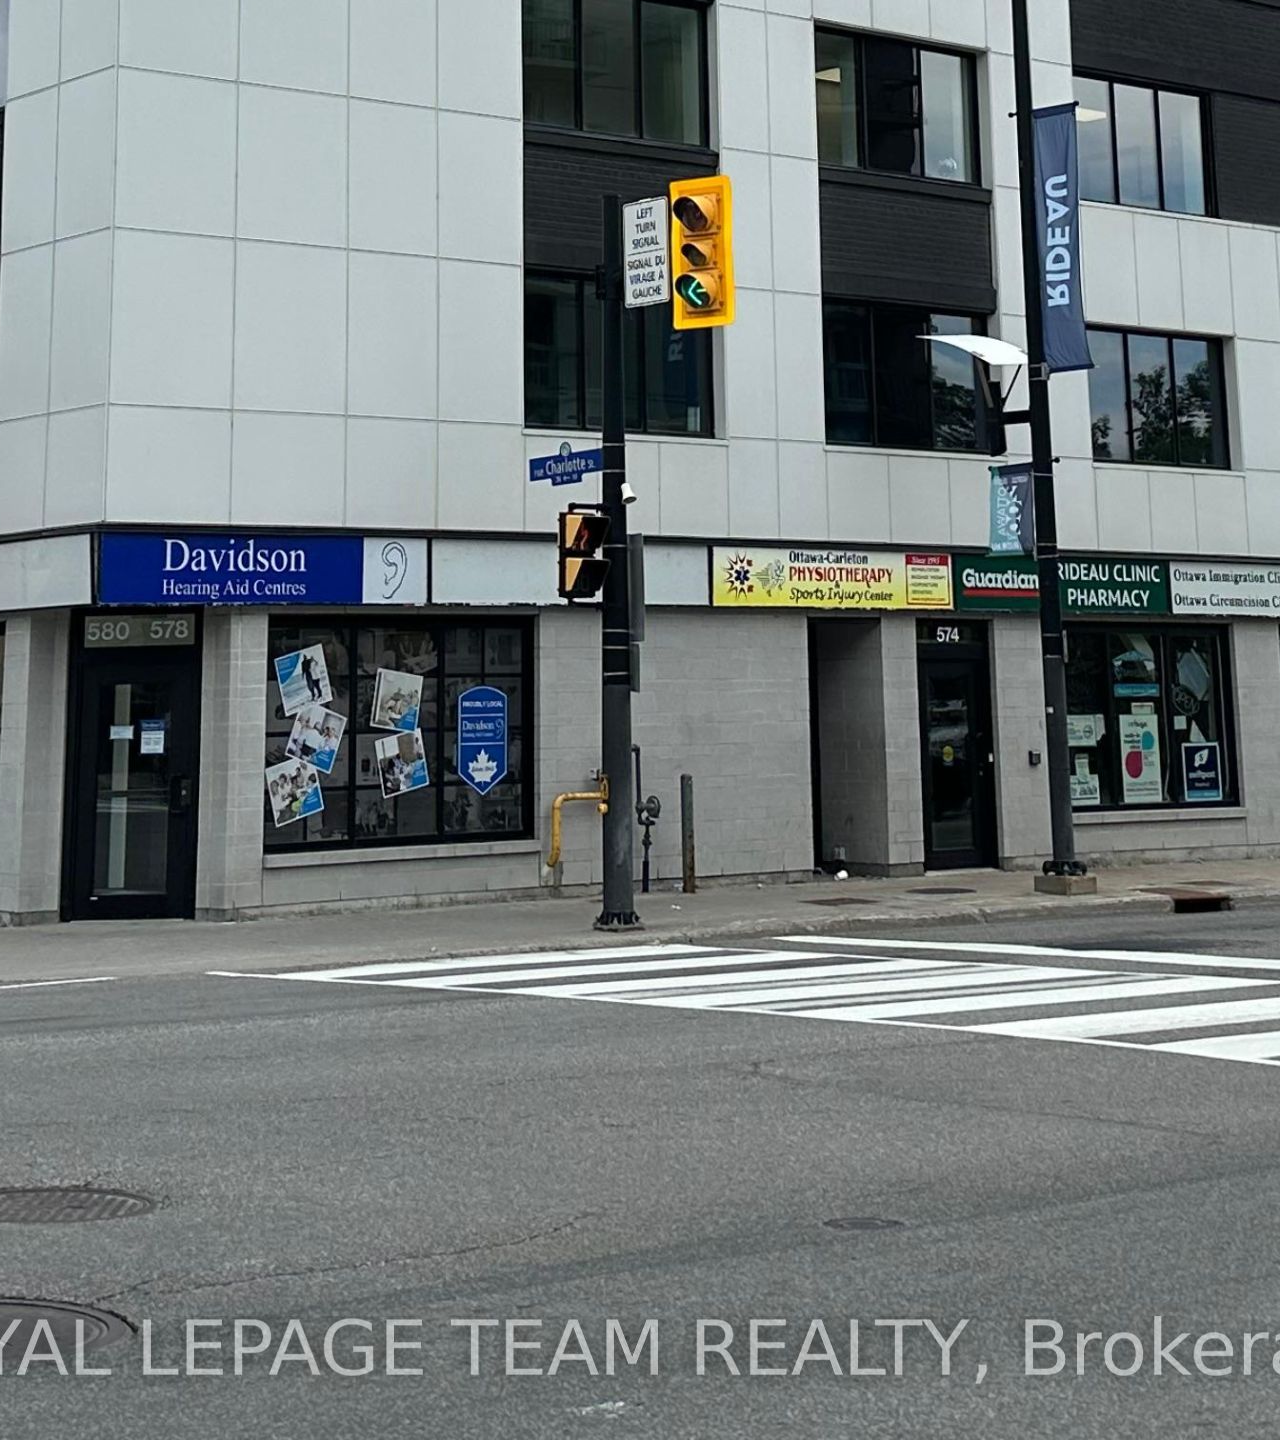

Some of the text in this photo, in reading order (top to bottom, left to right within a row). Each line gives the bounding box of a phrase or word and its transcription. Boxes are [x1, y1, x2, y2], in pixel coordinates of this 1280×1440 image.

[636, 207, 653, 219] LEFT
[635, 222, 656, 234] TURN
[632, 235, 659, 249] SIGNAL
[627, 255, 665, 271] SIGNAL DU
[630, 271, 655, 285] VIRAGE
[632, 285, 662, 300] GAUCHE
[545, 457, 586, 475] Charlotte
[162, 538, 307, 573] Davidson
[789, 551, 869, 564] Ottawa-Carleton
[789, 566, 893, 588] PHYSIOTHERAPY
[962, 567, 1039, 589] Guardian
[1058, 562, 1160, 582] RIDEAU CLINIC
[1173, 568, 1207, 582] Ottawa
[1209, 569, 1265, 585] Immigration
[162, 578, 306, 599] Hearing Aid Centres
[789, 587, 826, 604] Sports
[828, 587, 863, 605] Injury
[864, 590, 893, 601] Center
[1067, 588, 1150, 607] PHARMACY
[1174, 593, 1207, 606] Ottawa
[1209, 594, 1269, 608] Circumcision
[87, 620, 188, 641] 580 578
[936, 626, 960, 643] 574
[462, 719, 495, 731] Davidson
